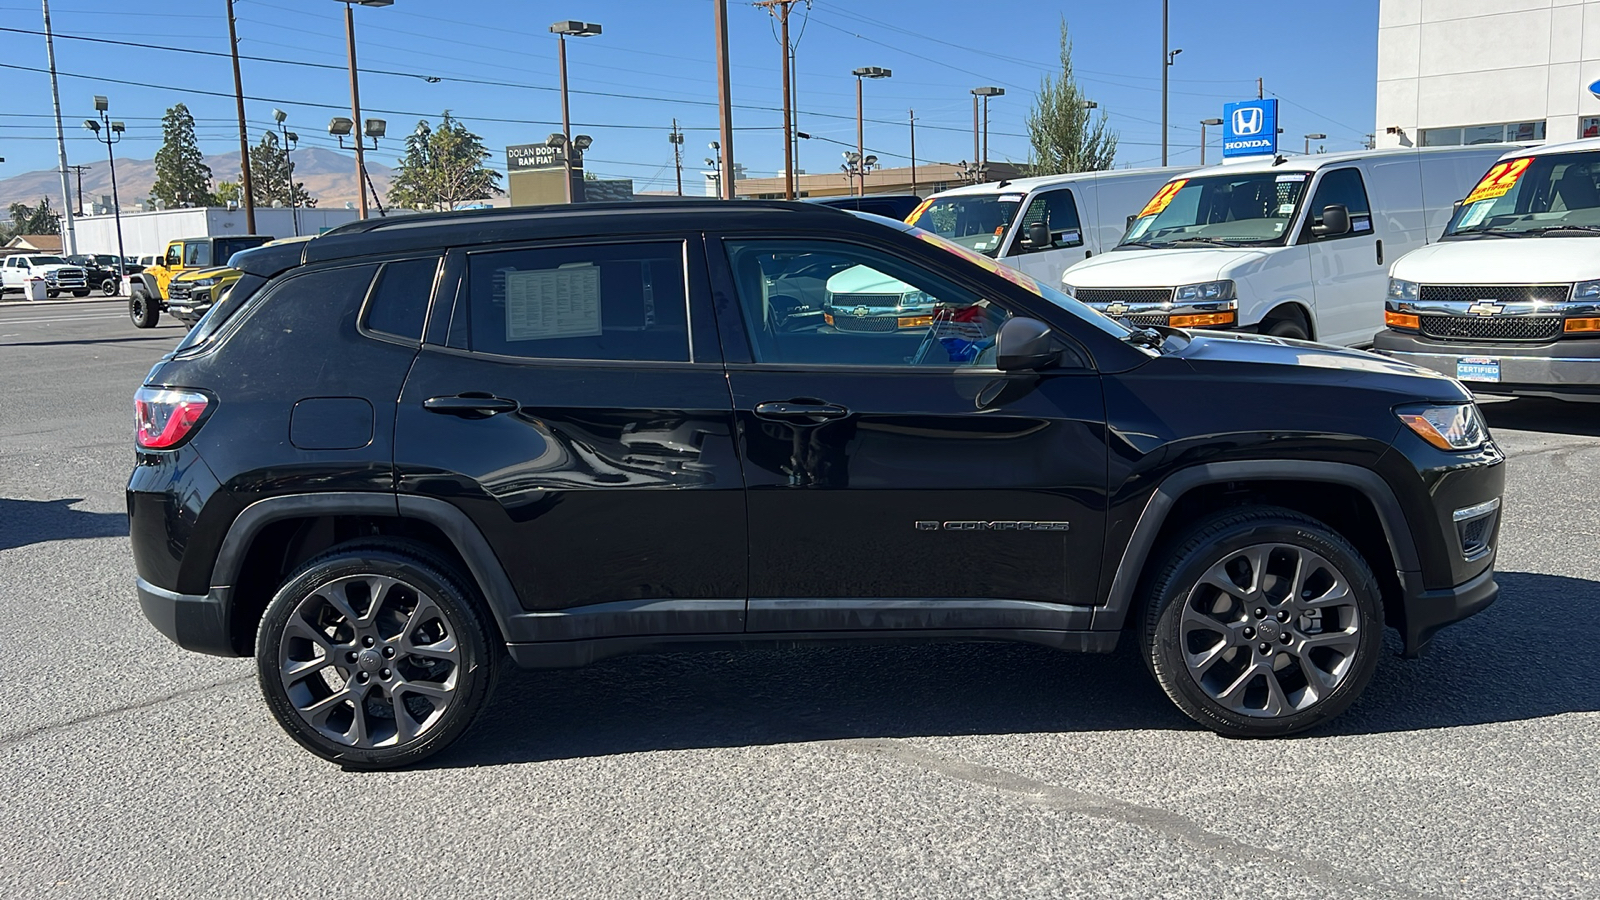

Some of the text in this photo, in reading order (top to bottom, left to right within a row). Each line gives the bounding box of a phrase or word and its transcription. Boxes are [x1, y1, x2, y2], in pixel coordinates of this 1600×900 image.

[1225, 140, 1271, 149] HONDA
[508, 149, 534, 158] DOLAN
[518, 156, 552, 166] RAM FIAT
[1476, 158, 1530, 189] 22
[943, 521, 1069, 530] COMPASS
